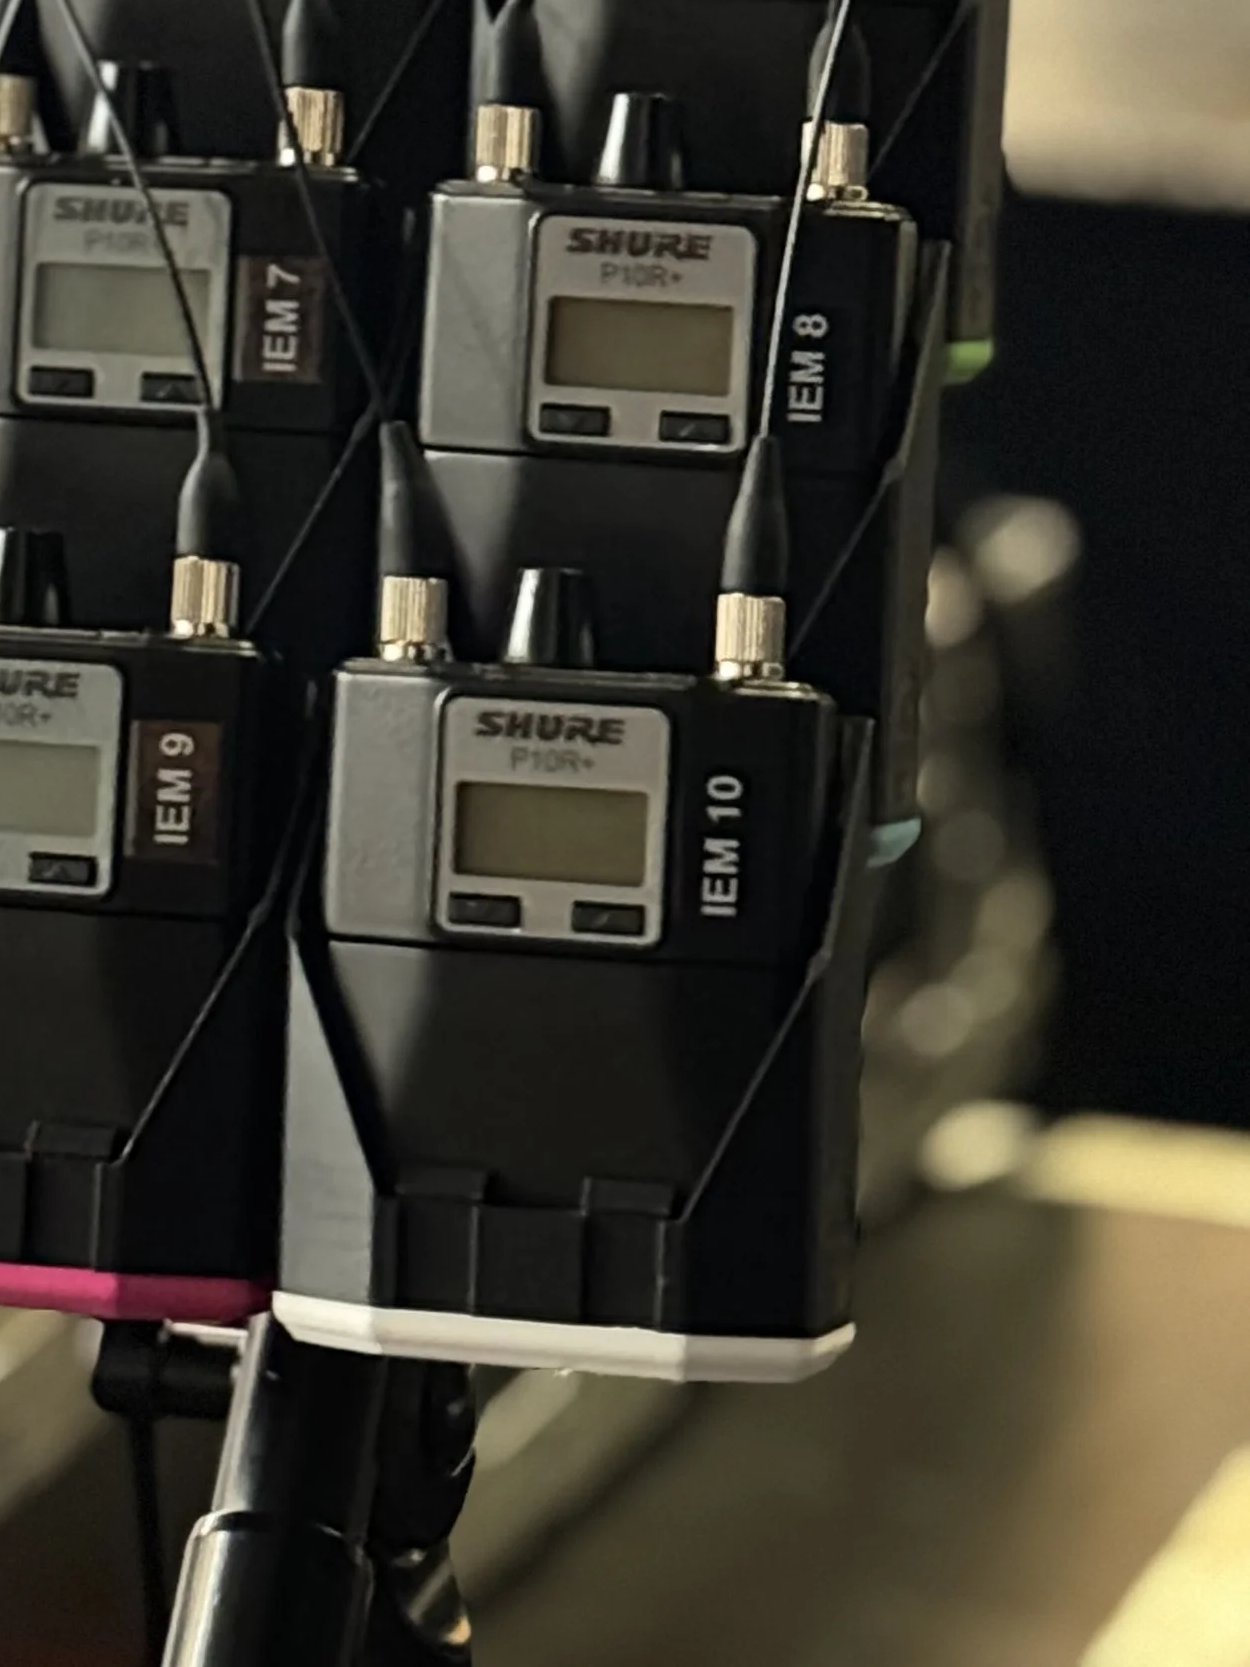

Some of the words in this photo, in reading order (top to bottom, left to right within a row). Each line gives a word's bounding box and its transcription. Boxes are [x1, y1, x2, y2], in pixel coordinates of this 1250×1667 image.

[565, 227, 713, 260] SHURE
[266, 263, 302, 288] 7
[599, 261, 683, 287] P10R+
[262, 300, 301, 372] IEM
[793, 312, 829, 339] 8
[785, 349, 825, 422] IEM
[475, 709, 626, 745] SHURE
[160, 732, 195, 757] 9
[510, 746, 595, 773] P10R+
[153, 768, 193, 845] IEM
[705, 774, 744, 822] 10
[700, 837, 741, 917] IEM
